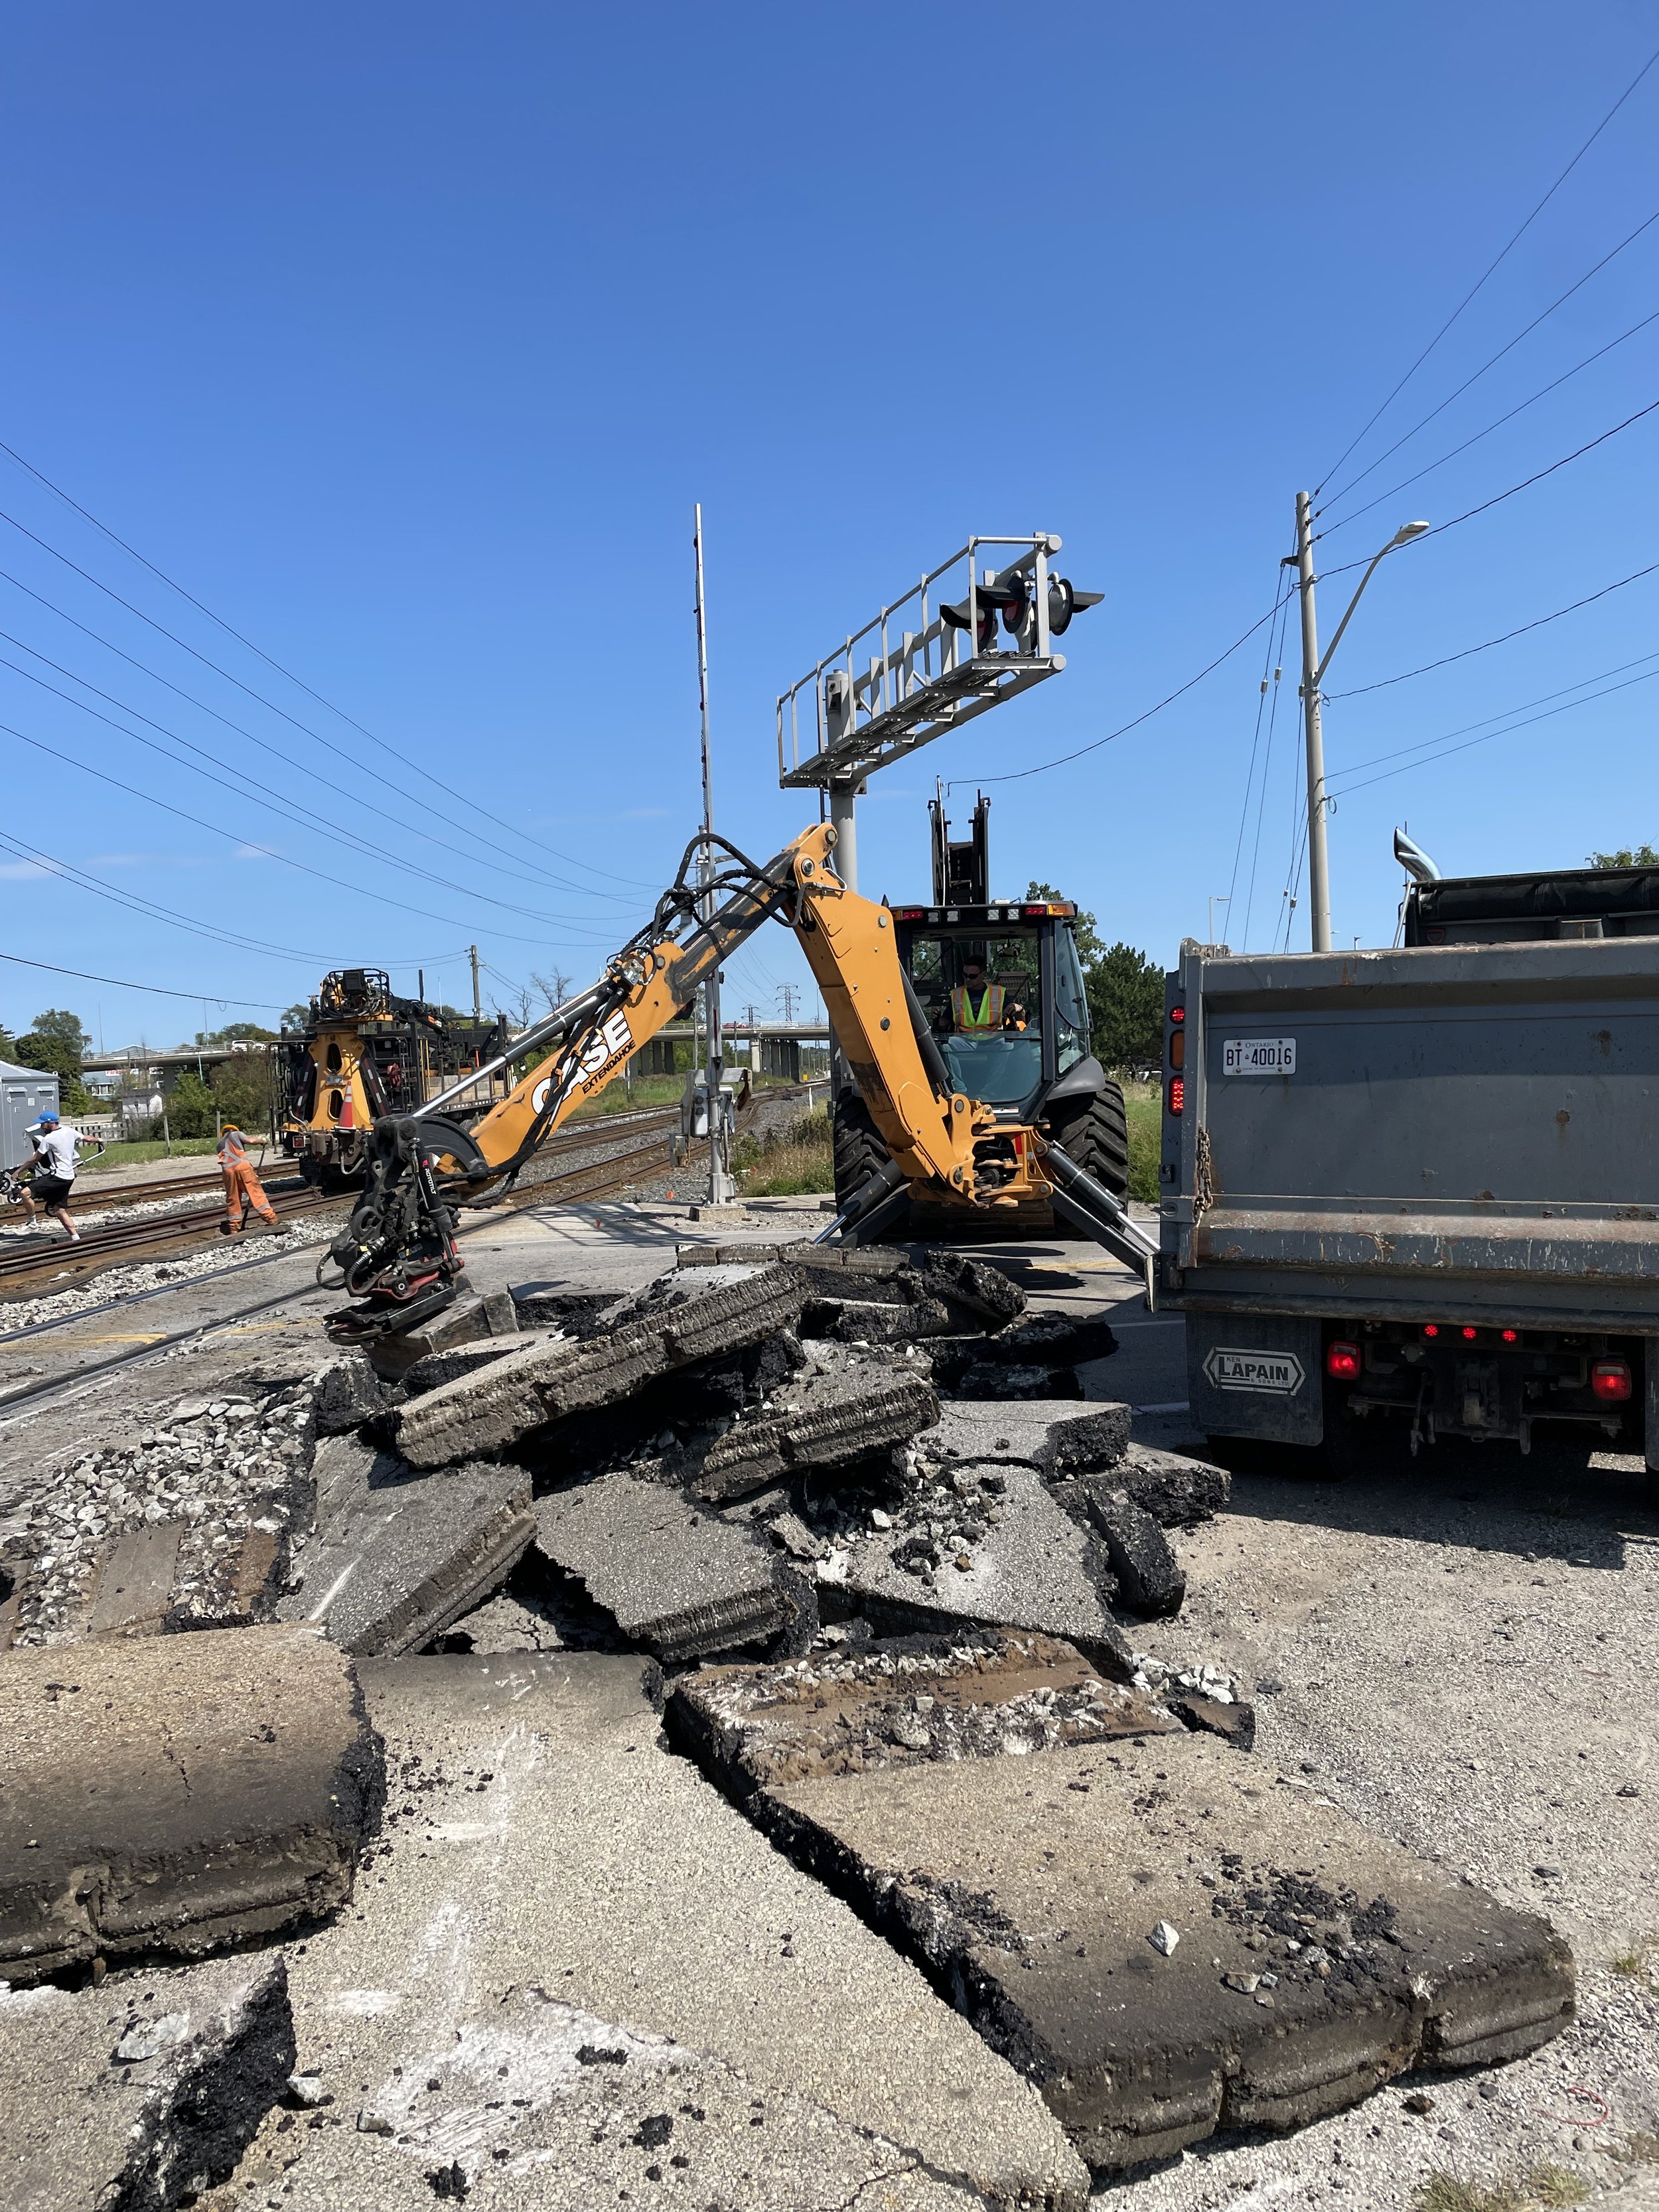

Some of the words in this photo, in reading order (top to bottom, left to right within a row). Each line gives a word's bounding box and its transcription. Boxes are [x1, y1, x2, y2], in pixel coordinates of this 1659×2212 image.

[582, 1039, 636, 1094] EXTENDAHOE
[1251, 1048, 1292, 1065] 40016
[425, 1169, 437, 1194] ROTOTILT
[1218, 1356, 1288, 1380] LAPAIN
